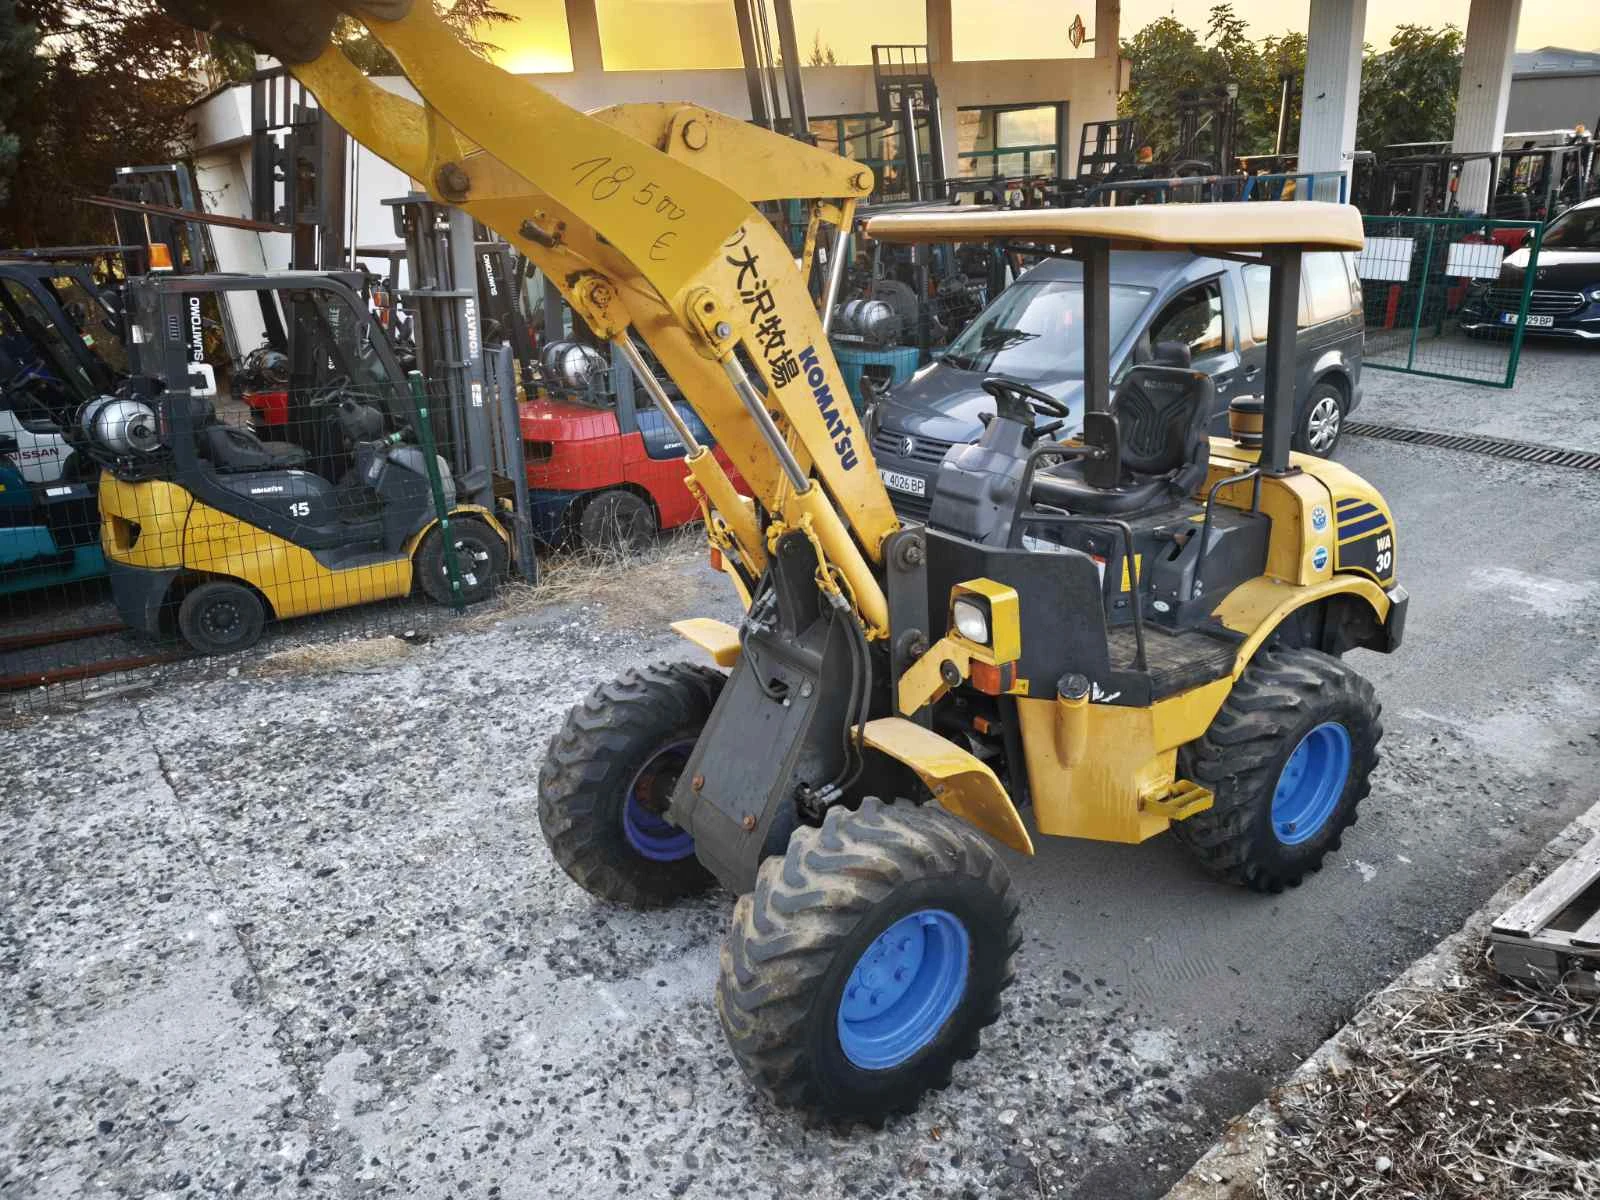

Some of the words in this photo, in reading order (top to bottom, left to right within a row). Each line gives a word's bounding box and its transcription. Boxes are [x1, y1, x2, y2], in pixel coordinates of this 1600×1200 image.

[483, 254, 498, 296] SUMITOMO
[189, 297, 204, 361] SUMITOMO
[799, 345, 859, 472] KOMATSU
[8, 447, 60, 461] NISSAN
[289, 501, 310, 517] 15
[1376, 534, 1392, 552] WA
[1375, 551, 1392, 573] 30
